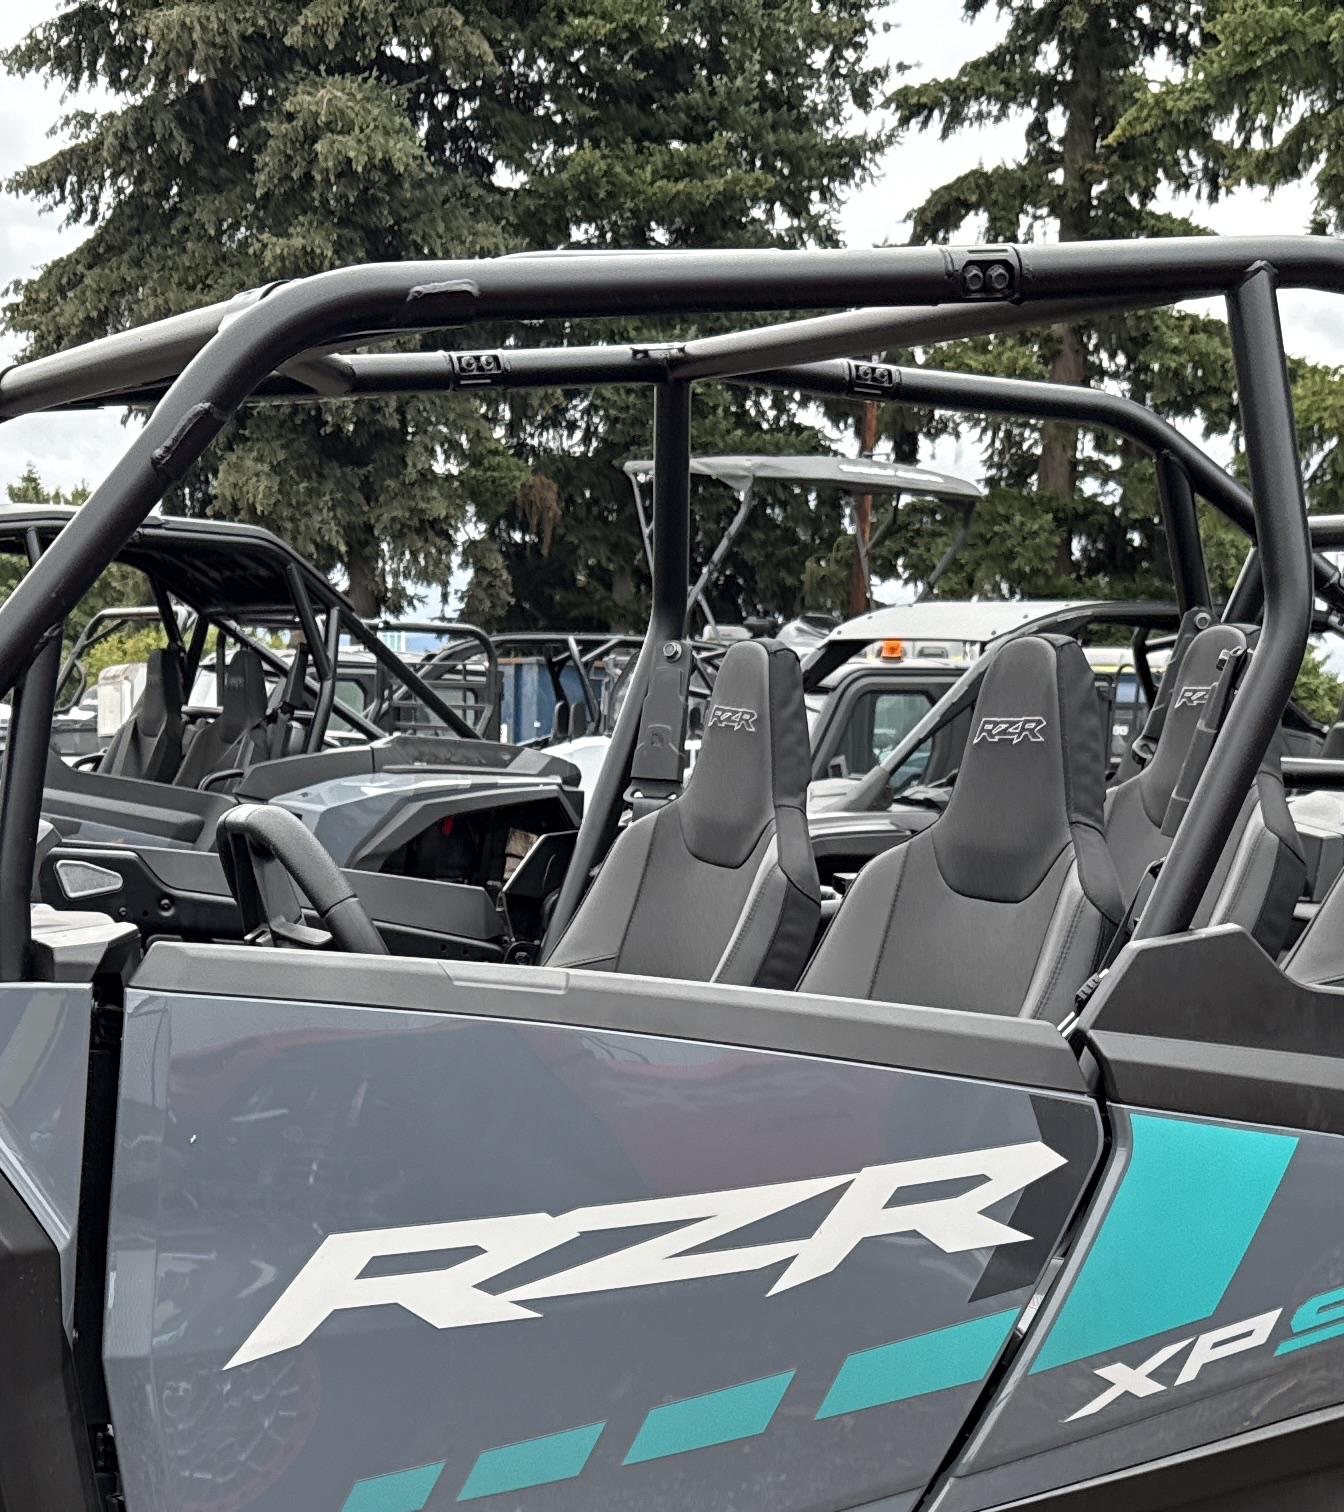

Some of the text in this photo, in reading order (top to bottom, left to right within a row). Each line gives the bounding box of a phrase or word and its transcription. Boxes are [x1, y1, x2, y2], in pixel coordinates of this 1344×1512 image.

[1174, 681, 1217, 709] RZ
[707, 704, 759, 733] RZR
[972, 715, 1047, 745] RZR
[222, 1140, 1068, 1371] RZR
